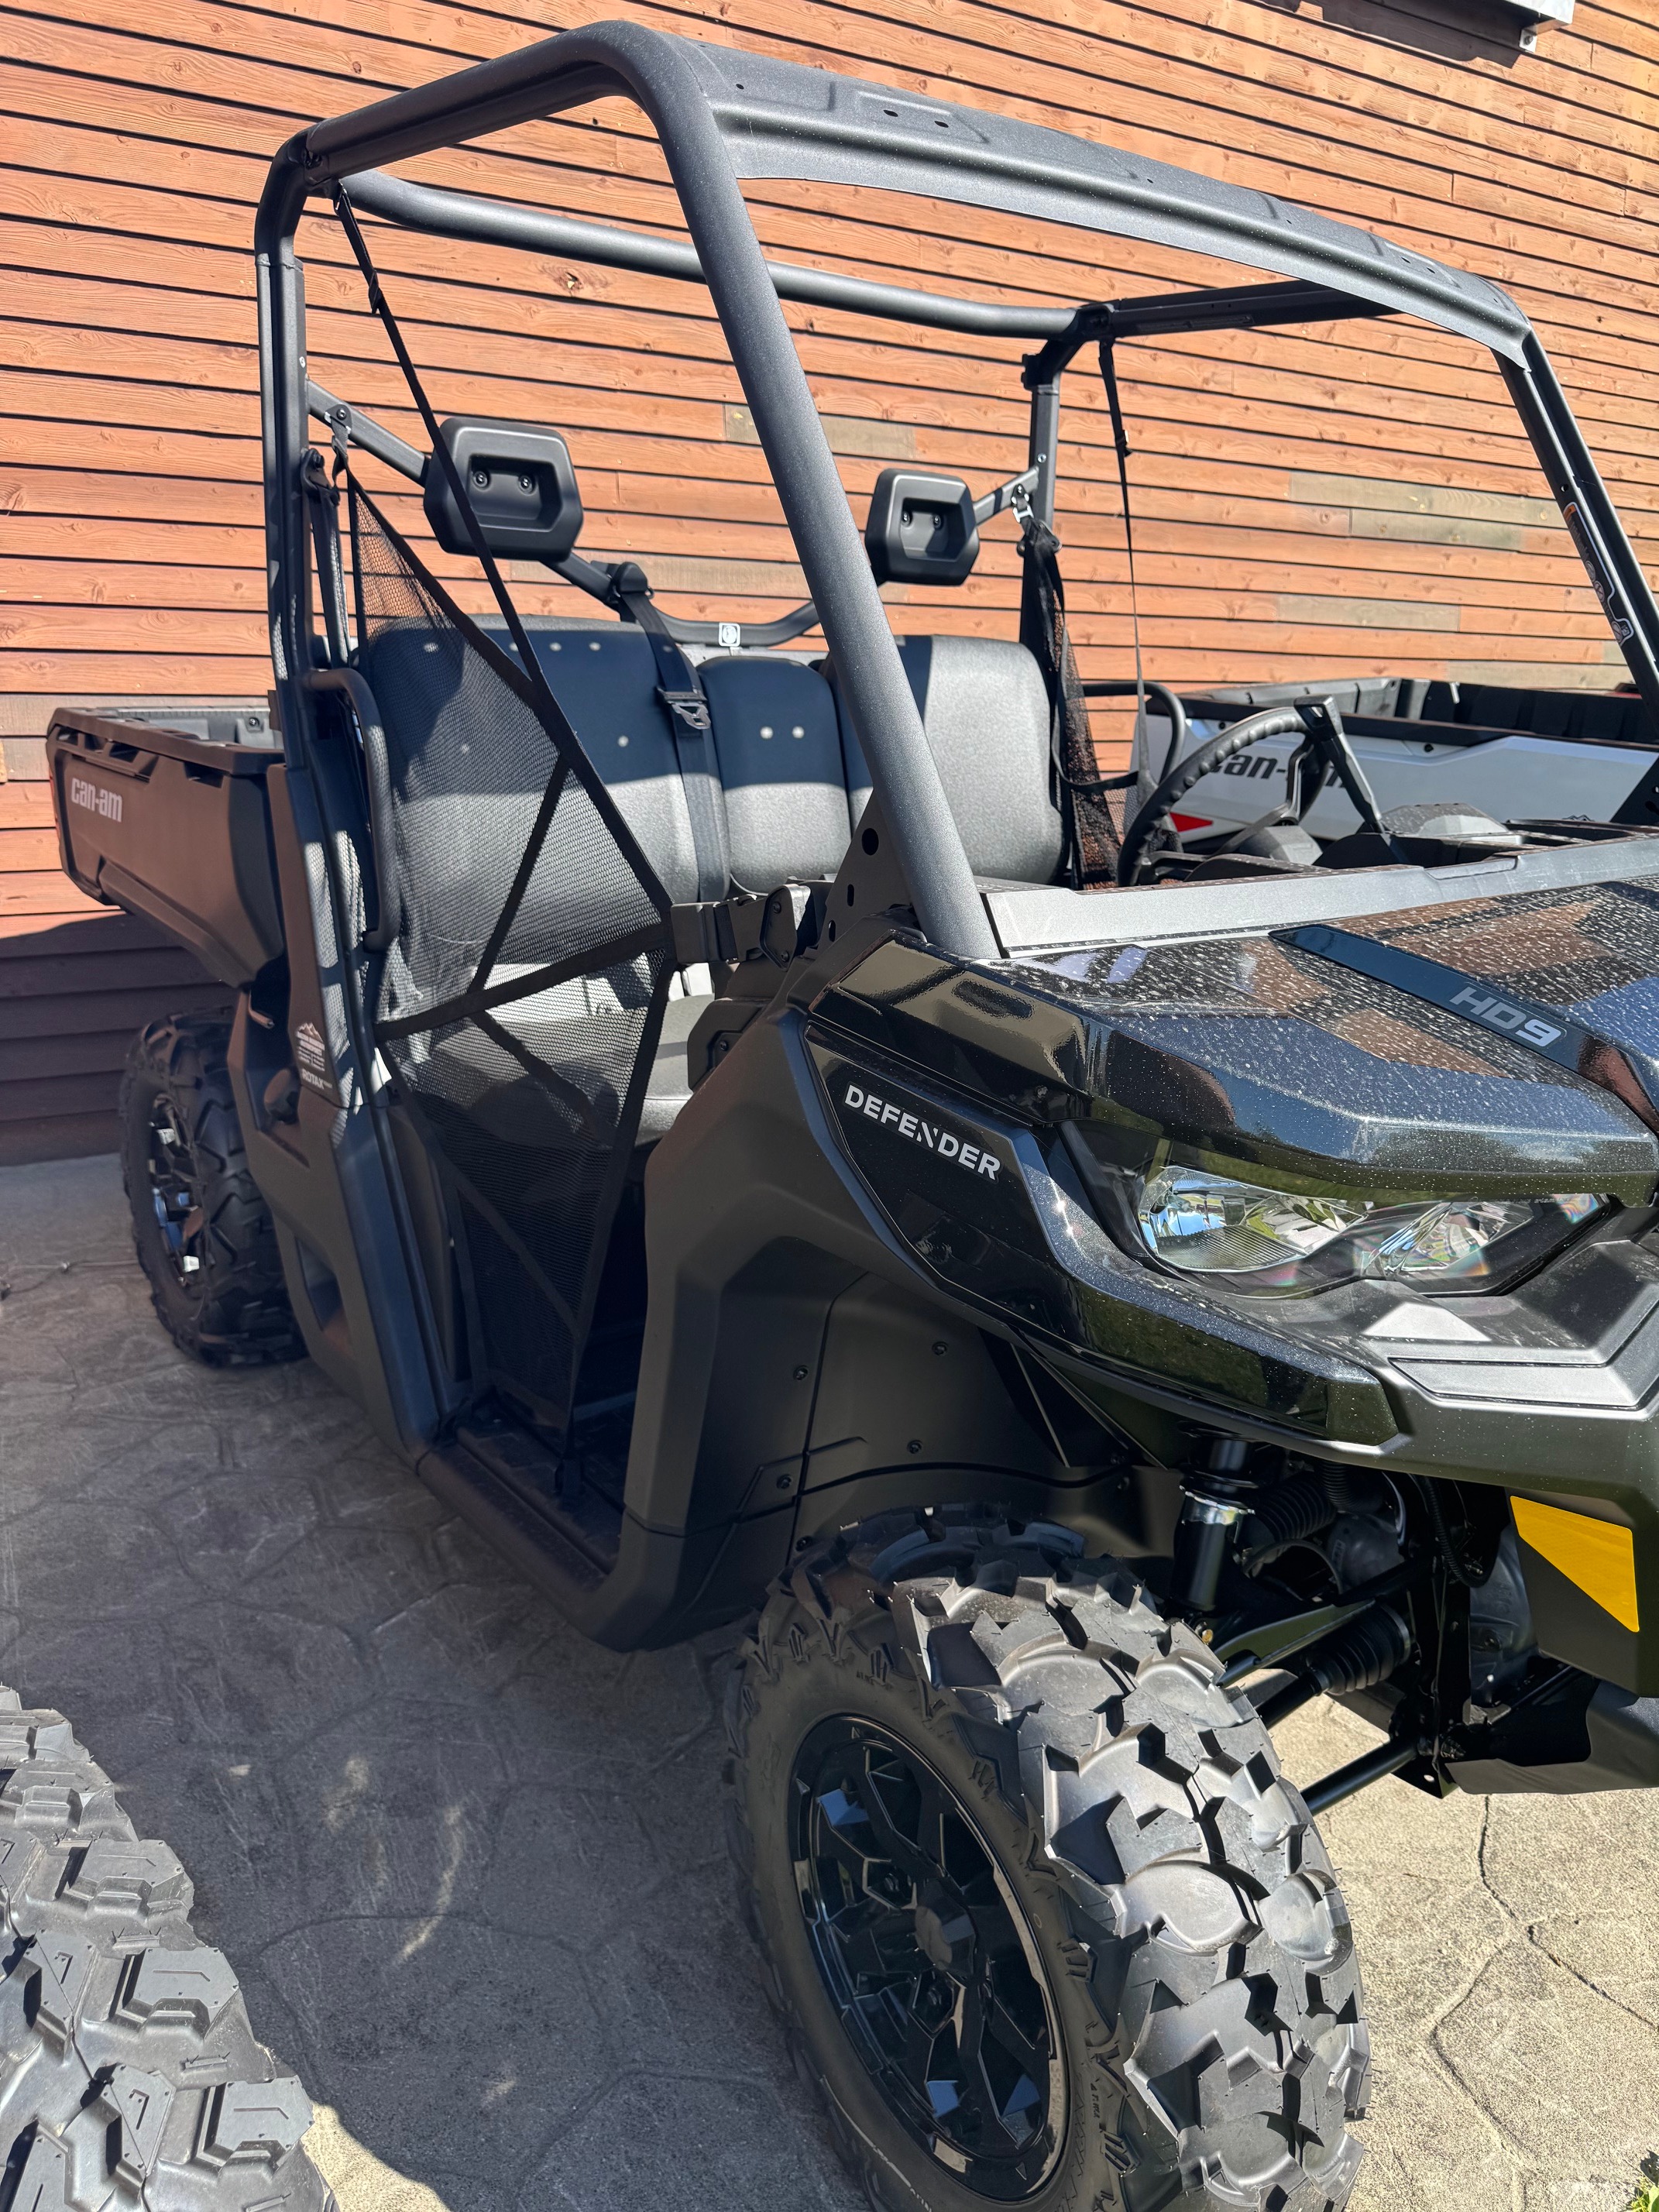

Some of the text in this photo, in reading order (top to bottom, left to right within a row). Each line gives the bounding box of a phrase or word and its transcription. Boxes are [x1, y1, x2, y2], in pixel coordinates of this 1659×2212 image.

[1210, 754, 1346, 788] an-
[71, 778, 122, 823] can-am
[1449, 986, 1561, 1047] HD9
[845, 1084, 1001, 1180] DEFENDER
